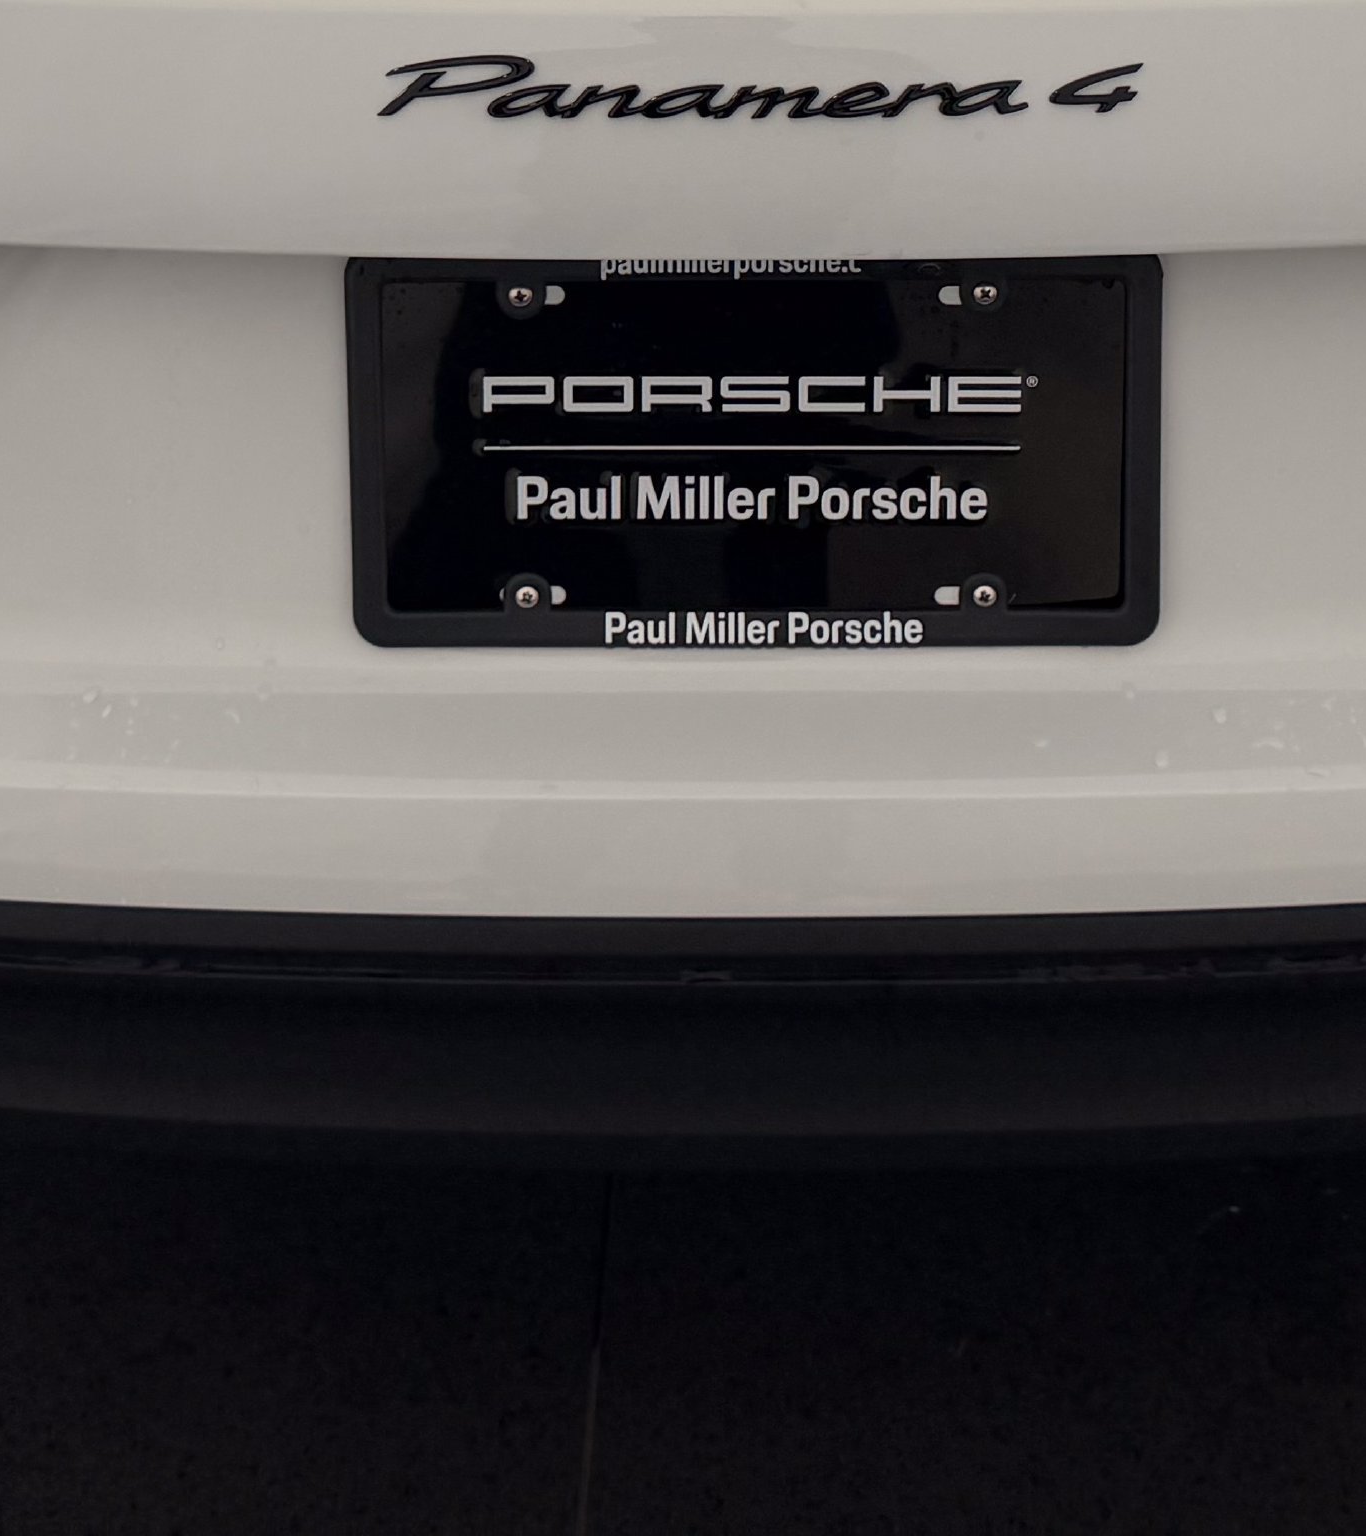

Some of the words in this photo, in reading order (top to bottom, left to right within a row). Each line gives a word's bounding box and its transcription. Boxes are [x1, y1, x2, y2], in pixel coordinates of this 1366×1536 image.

[376, 54, 1031, 121] Panamera
[1048, 62, 1145, 114] 4
[515, 475, 622, 521] Paul
[636, 475, 776, 521] Miller
[788, 475, 988, 522] Porsche
[604, 611, 677, 646] Paul
[685, 611, 781, 646] Miller
[787, 610, 925, 646] Porsche
